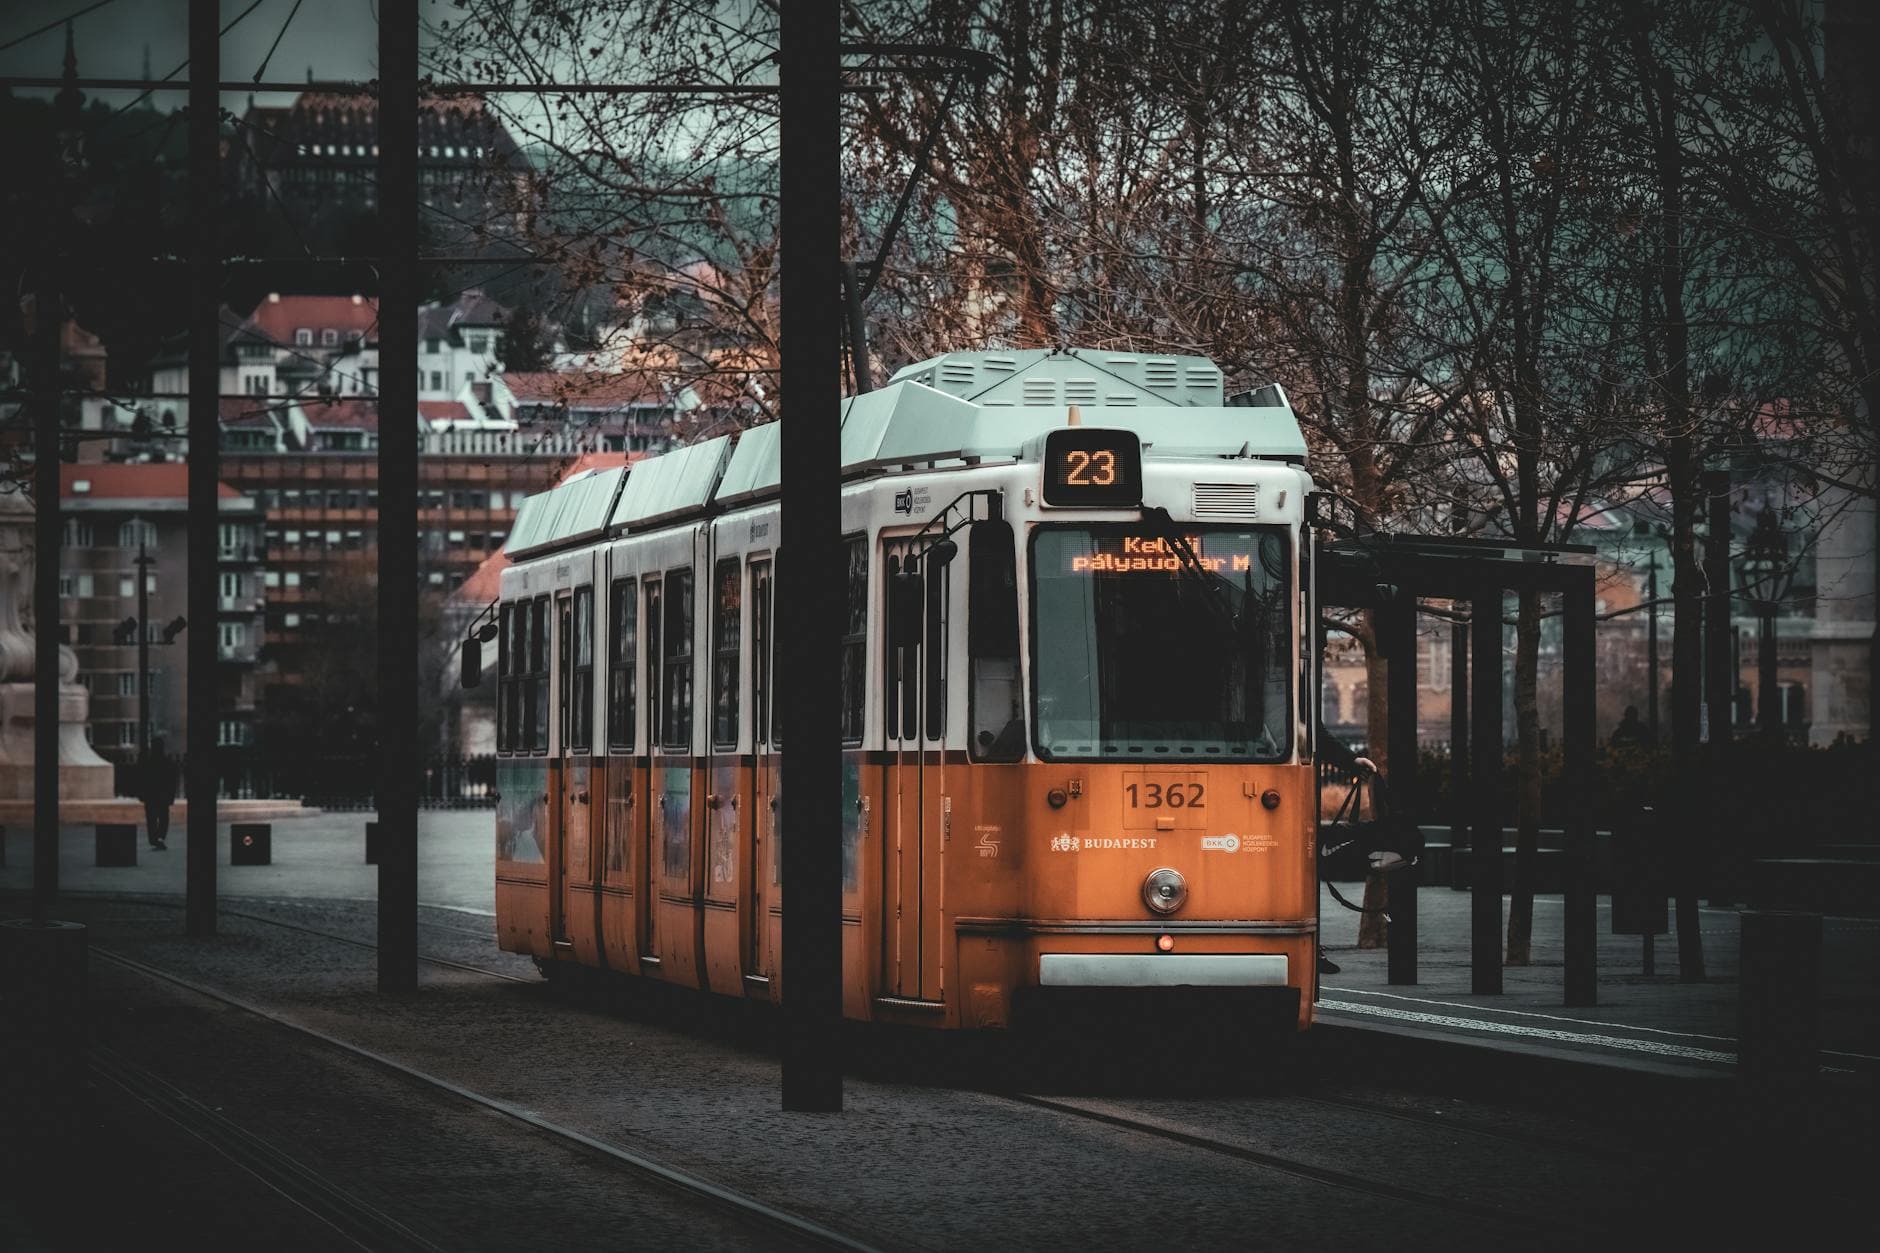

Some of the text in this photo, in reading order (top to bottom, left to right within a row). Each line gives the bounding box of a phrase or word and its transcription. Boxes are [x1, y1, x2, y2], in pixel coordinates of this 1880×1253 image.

[1067, 450, 1115, 485] 23
[1124, 536, 1199, 553] Keli
[1233, 554, 1249, 570] M
[1125, 783, 1205, 808] 1362
[1084, 838, 1157, 849] BUDAPEST
